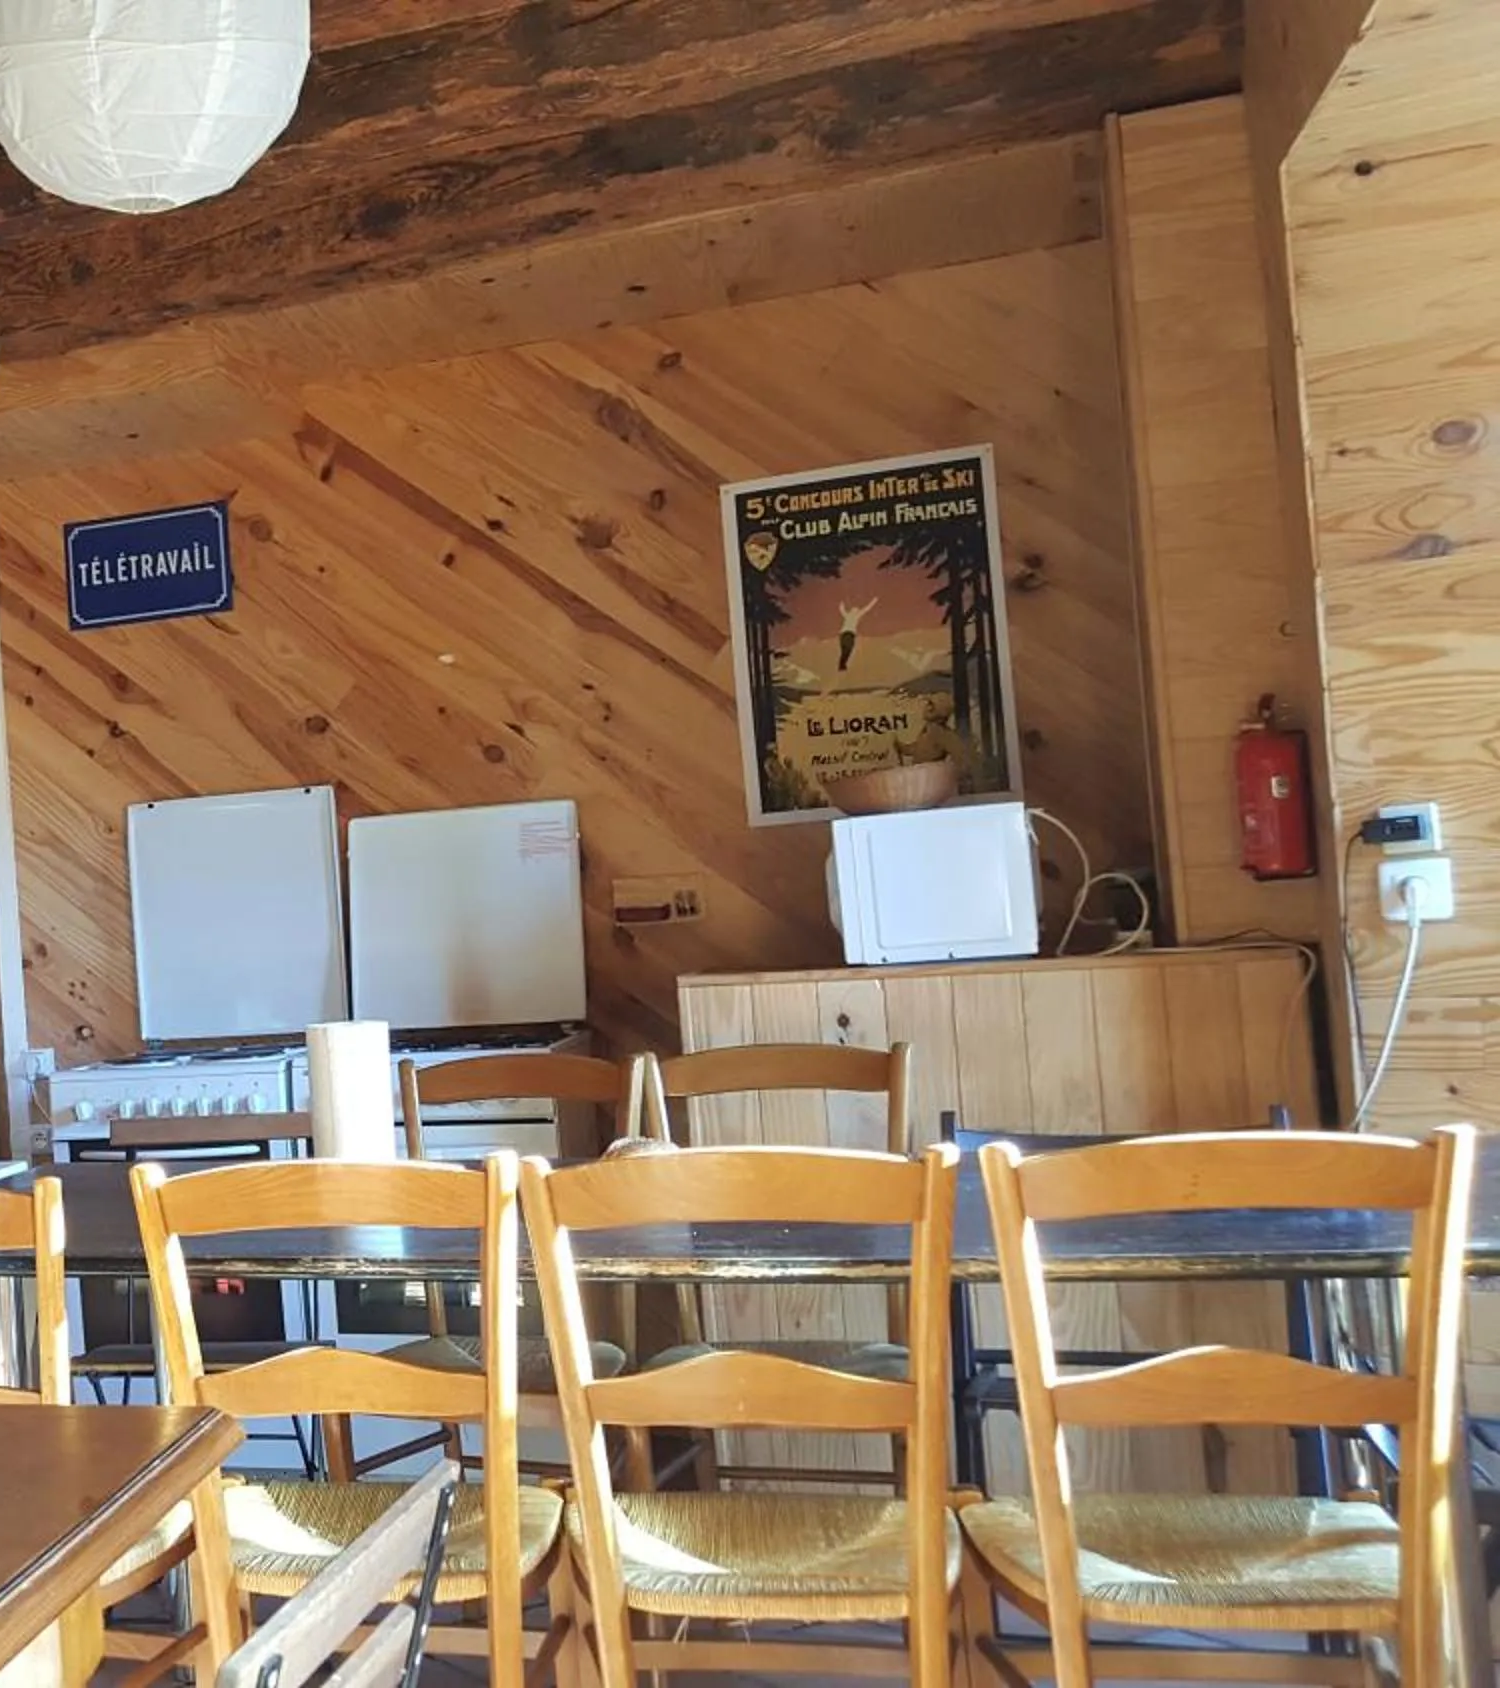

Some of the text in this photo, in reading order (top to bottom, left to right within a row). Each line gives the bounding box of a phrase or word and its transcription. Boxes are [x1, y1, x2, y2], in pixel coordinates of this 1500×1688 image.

[774, 485, 865, 513] CONCOURS
[942, 468, 976, 489] SKI
[780, 519, 831, 540] CLUB
[838, 511, 888, 533] ALPIN
